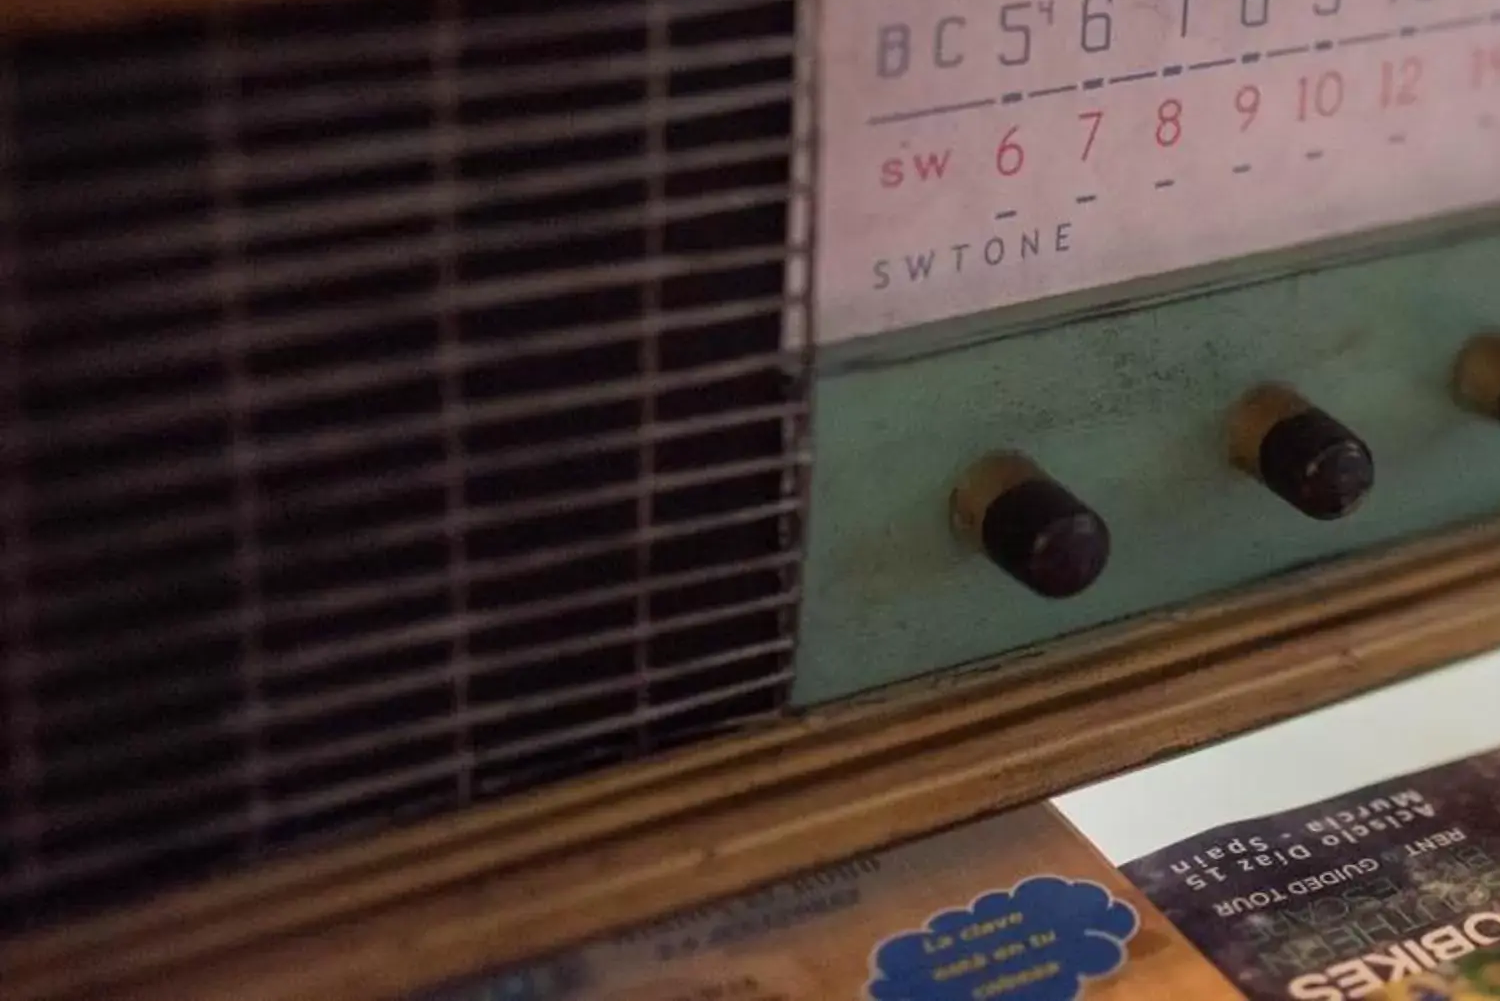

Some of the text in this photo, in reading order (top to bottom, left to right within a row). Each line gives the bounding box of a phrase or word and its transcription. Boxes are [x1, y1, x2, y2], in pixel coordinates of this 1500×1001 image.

[876, 16, 967, 78] BC
[880, 149, 953, 188] SW
[995, 125, 1024, 177] 6
[1078, 111, 1105, 162] 7
[1155, 98, 1183, 148] 8
[1235, 84, 1262, 133] 9
[1297, 69, 1346, 123] 10
[1379, 55, 1424, 110] 12
[1306, 789, 1424, 832] Murcia
[1322, 803, 1435, 846] Acisclo
[1170, 836, 1269, 875] Spain
[1404, 827, 1467, 857] RENT
[1186, 866, 1228, 891] 15
[1289, 858, 1379, 895] GUIDED
[1212, 887, 1286, 917] TOUR
